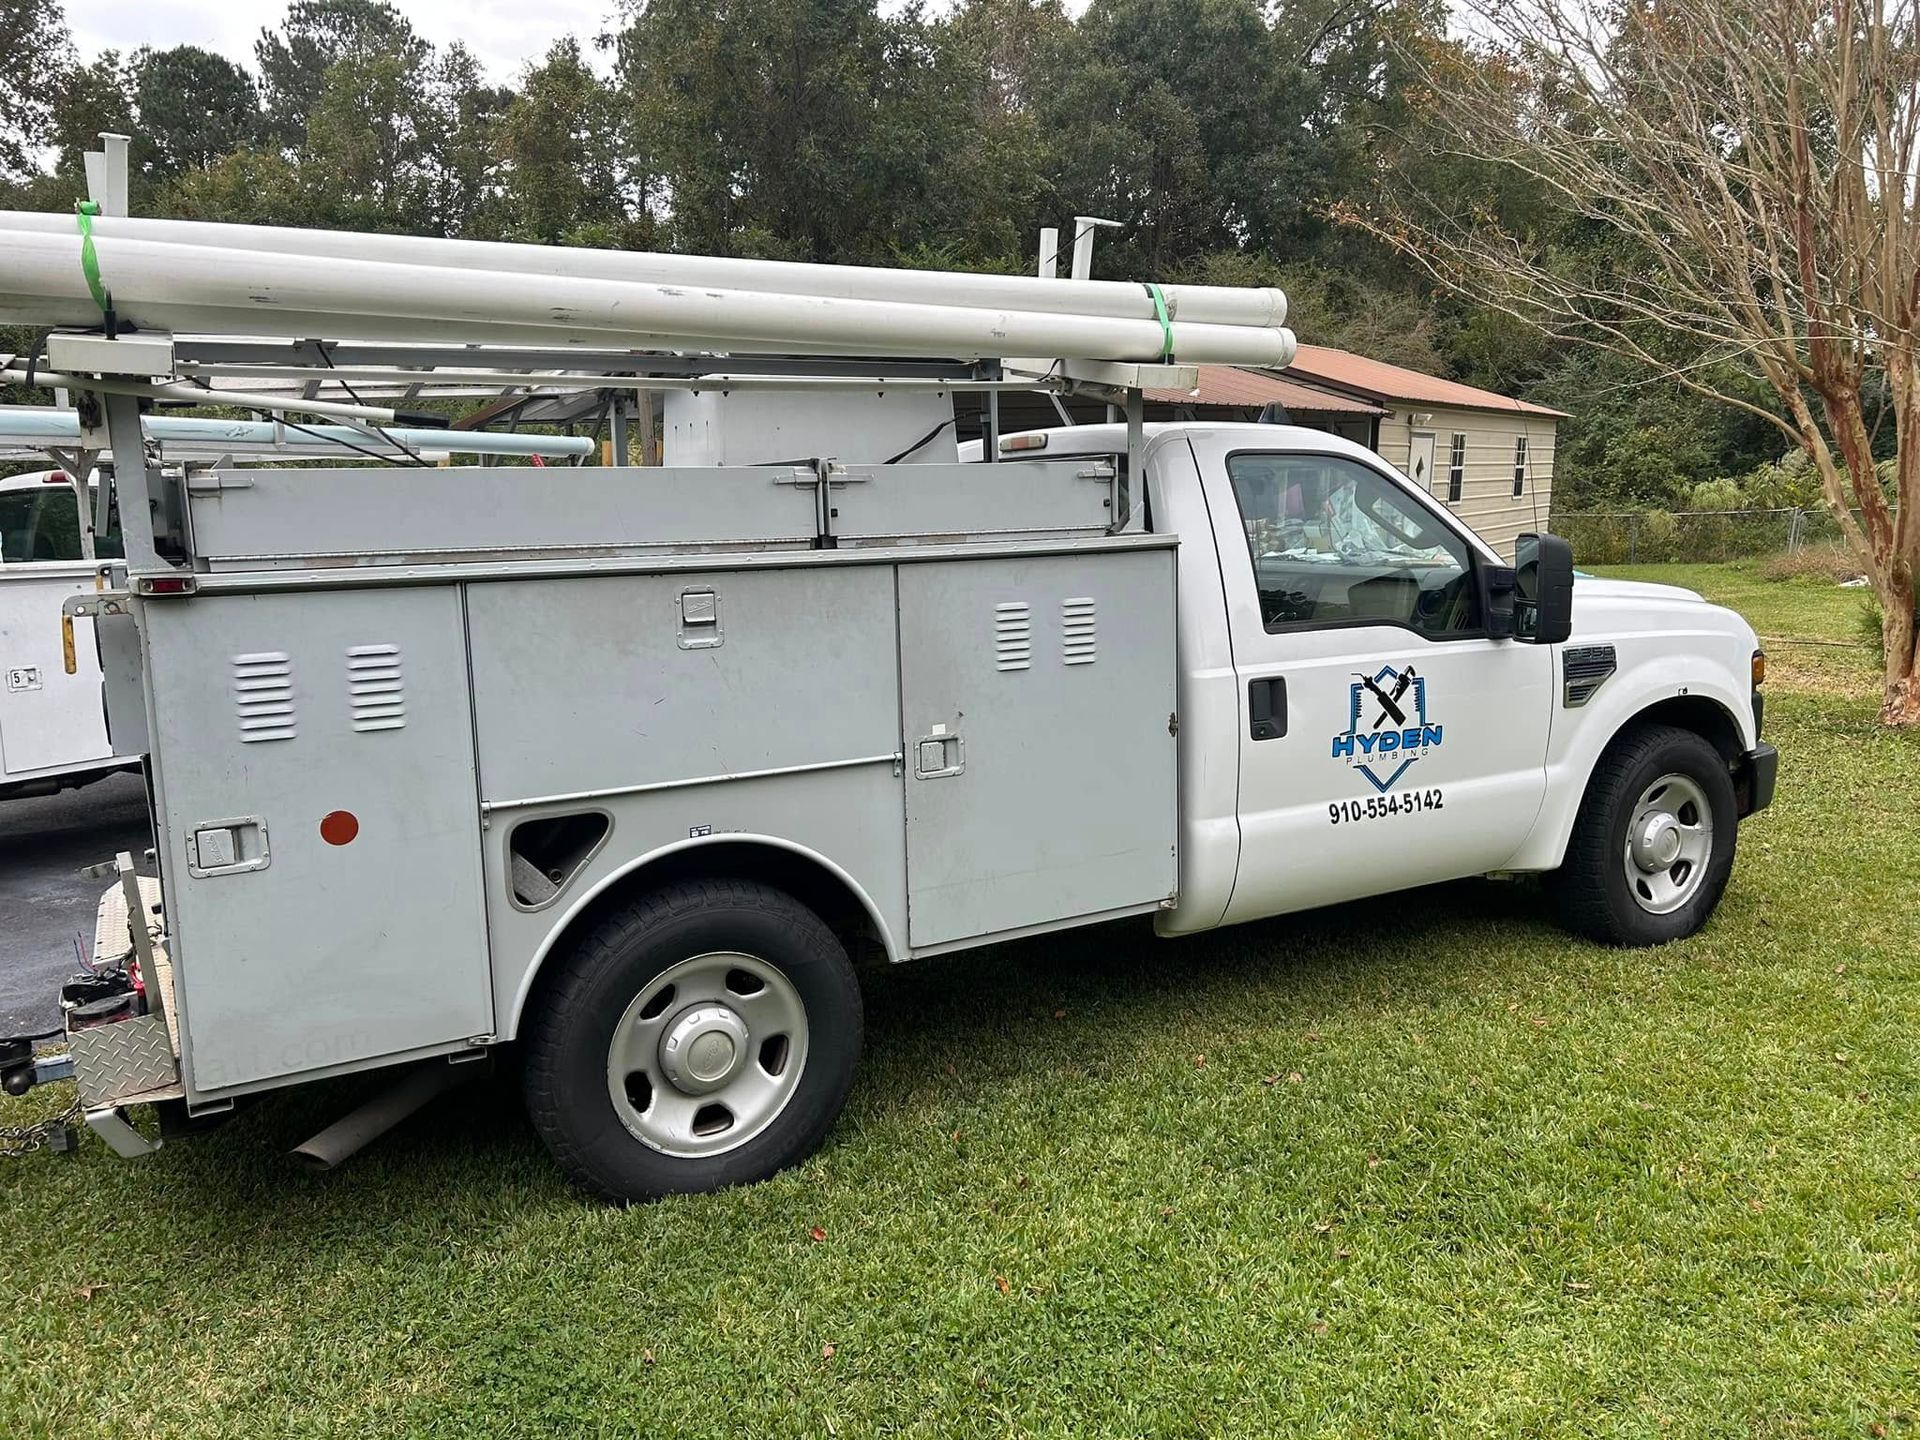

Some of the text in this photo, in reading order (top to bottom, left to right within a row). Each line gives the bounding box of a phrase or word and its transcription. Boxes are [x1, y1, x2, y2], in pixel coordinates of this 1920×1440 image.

[1332, 725, 1443, 758] HYDEN
[1346, 748, 1429, 765] PLUMBING
[1328, 789, 1444, 825] 910-554-5142
